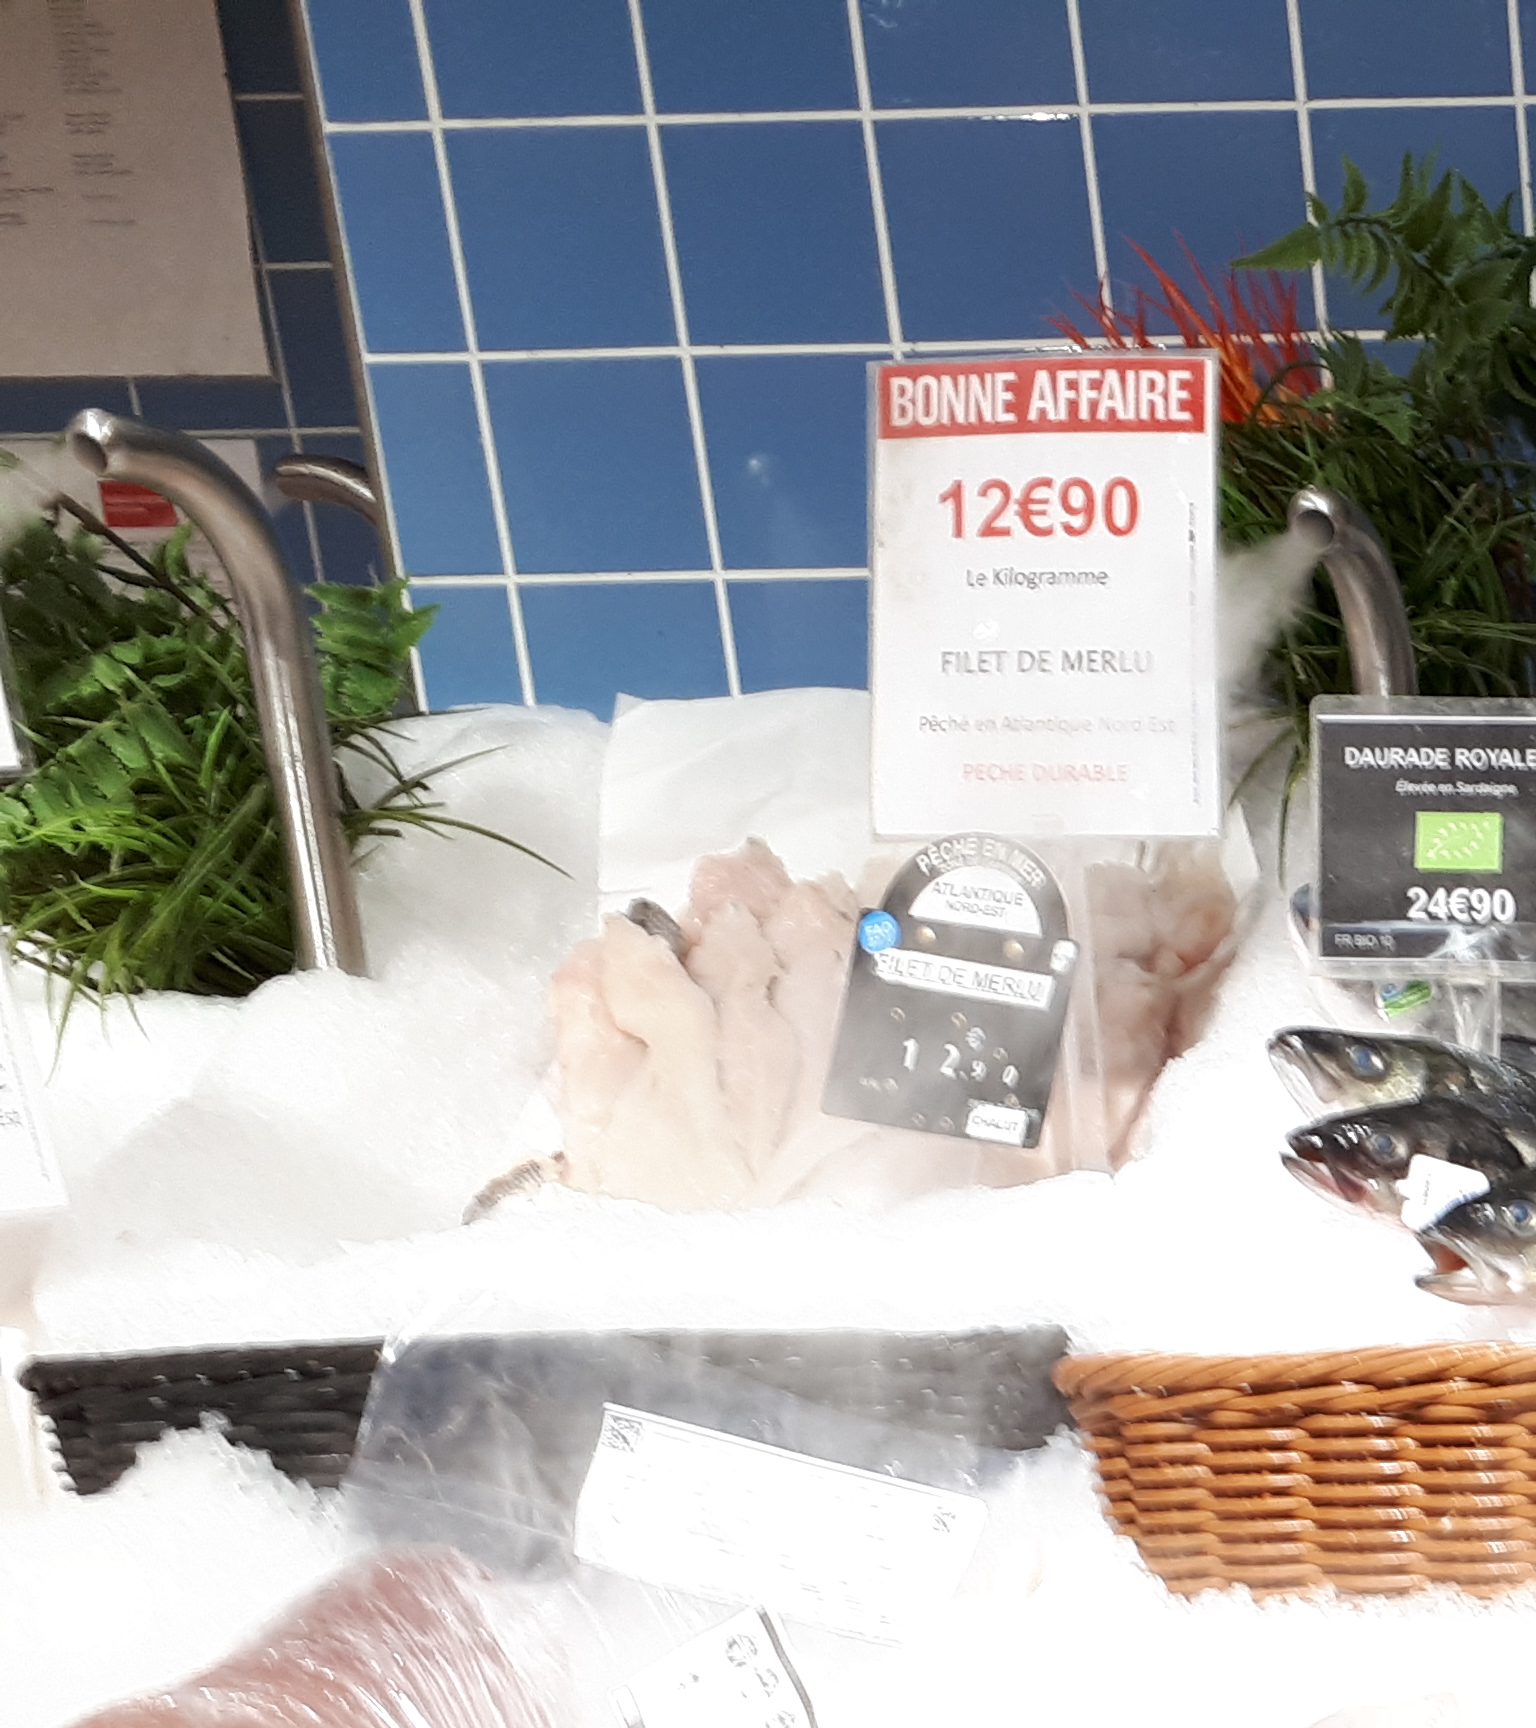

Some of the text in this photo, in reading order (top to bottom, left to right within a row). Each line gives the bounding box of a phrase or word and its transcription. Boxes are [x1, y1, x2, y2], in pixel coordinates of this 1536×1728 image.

[890, 369, 1193, 426] BONNE AFFAIRE
[939, 477, 1139, 538] 12€90
[966, 567, 1108, 591] Le Kilogramme
[940, 650, 1154, 674] FILET DE MERLU
[1002, 717, 1092, 735] Atlantique
[1344, 747, 1450, 769] DAURADE
[1033, 763, 1129, 782] DURABLE
[931, 881, 1025, 906] ATLANTIQUE
[1406, 887, 1517, 923] 24€90
[877, 953, 936, 978] FILET
[941, 966, 965, 984] DE
